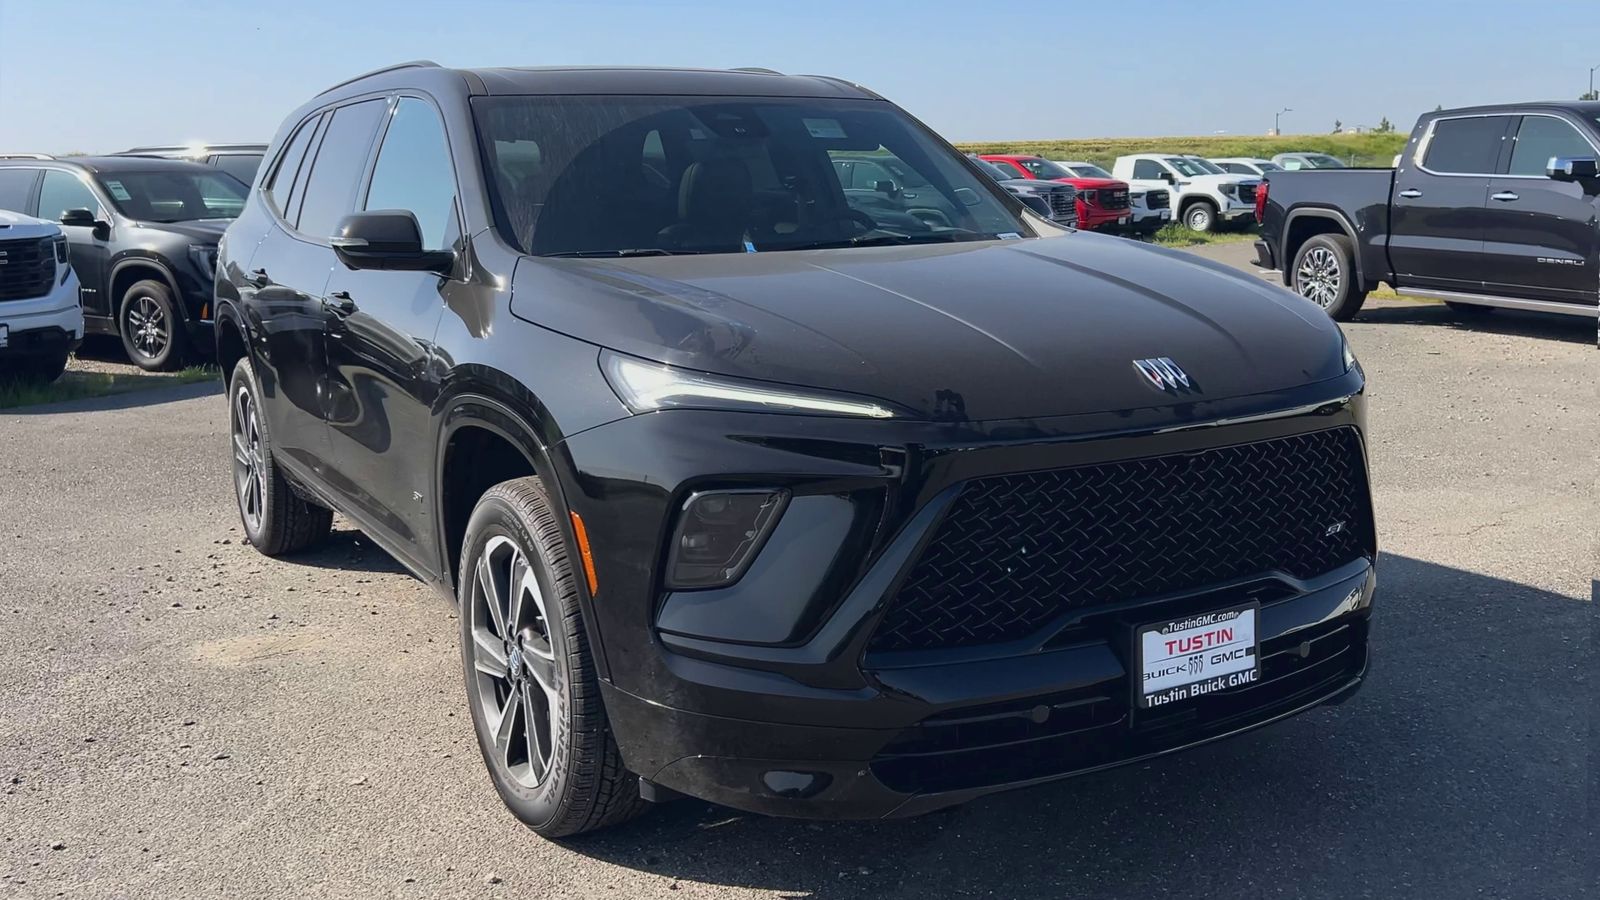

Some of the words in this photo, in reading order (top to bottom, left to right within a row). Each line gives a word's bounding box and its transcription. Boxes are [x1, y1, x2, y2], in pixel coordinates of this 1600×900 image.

[1537, 257, 1585, 266] DENALI
[1168, 611, 1235, 633] TustinGMC.com
[1164, 627, 1234, 656] TUSTIN
[1143, 663, 1188, 681] BUICK
[1210, 648, 1244, 665] GMC
[1145, 687, 1187, 708] Tustin
[1190, 676, 1226, 697] Buick
[1228, 669, 1258, 687] GMC
